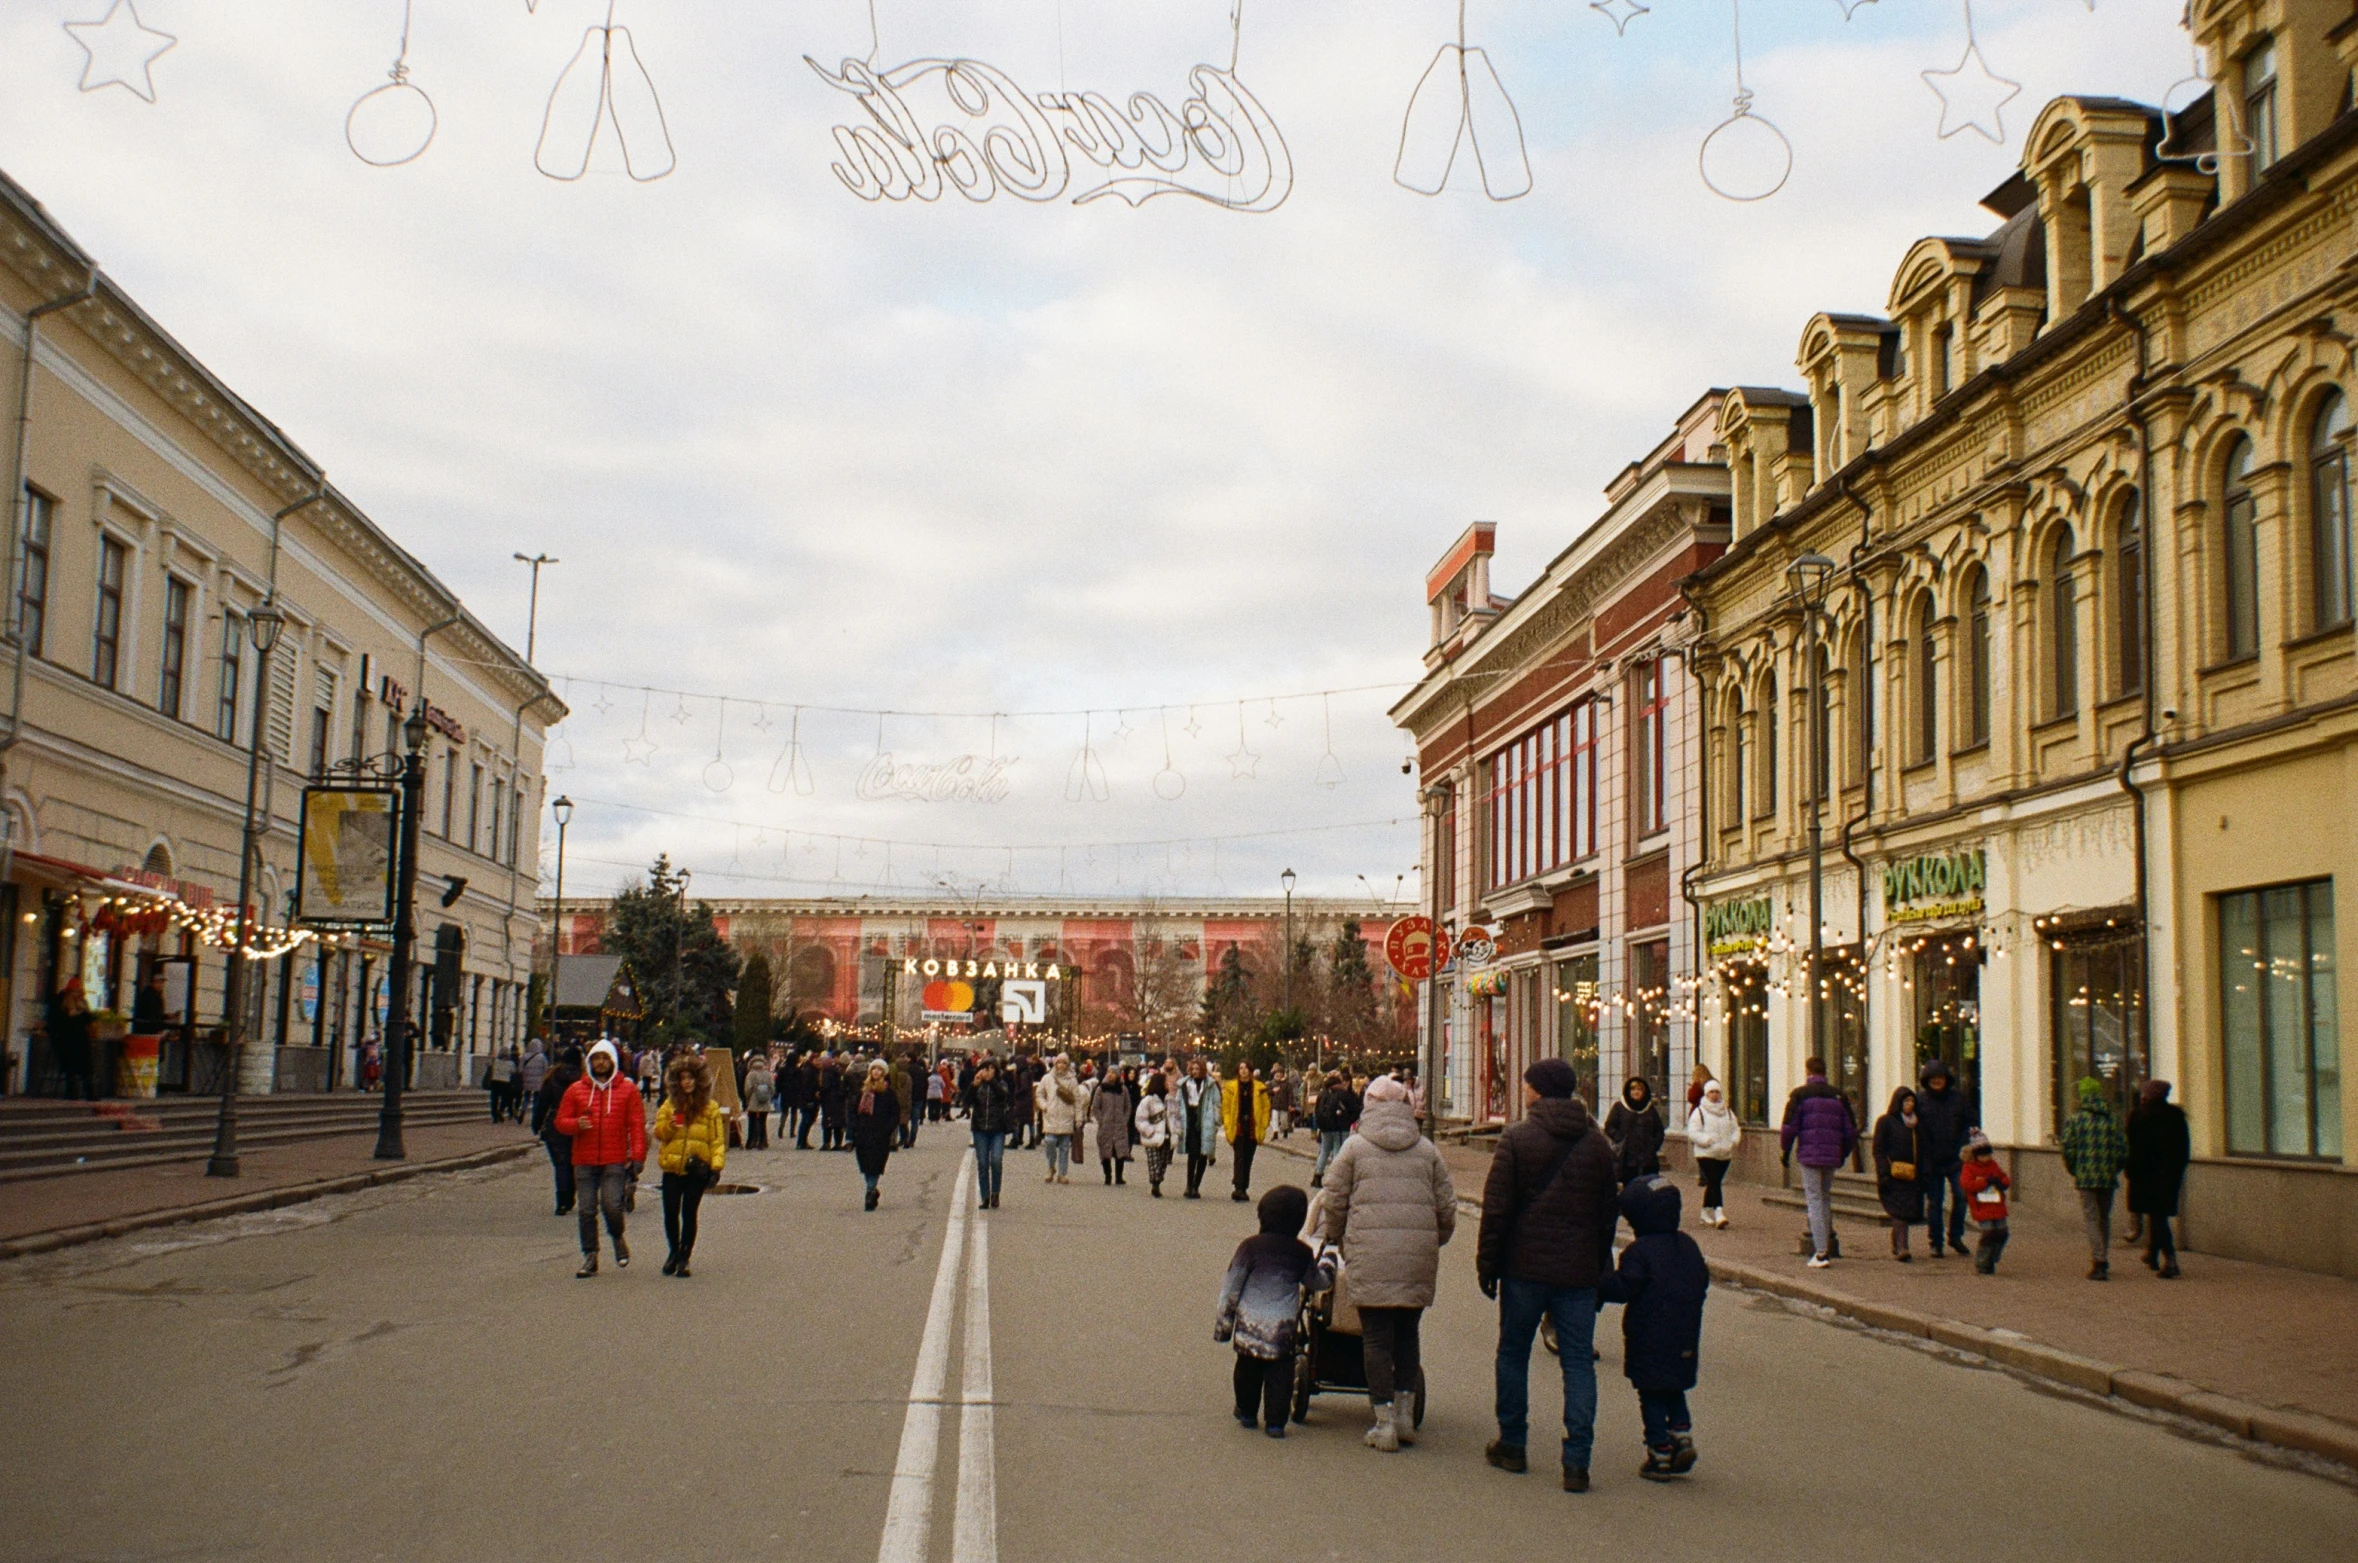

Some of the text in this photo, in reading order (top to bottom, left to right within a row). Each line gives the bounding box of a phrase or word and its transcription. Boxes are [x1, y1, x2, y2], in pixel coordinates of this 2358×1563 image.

[1884, 849, 1985, 905] РУККОЛА
[1705, 898, 1771, 940] РУККОЛА
[904, 958, 1061, 980] КОВЗАНКА
